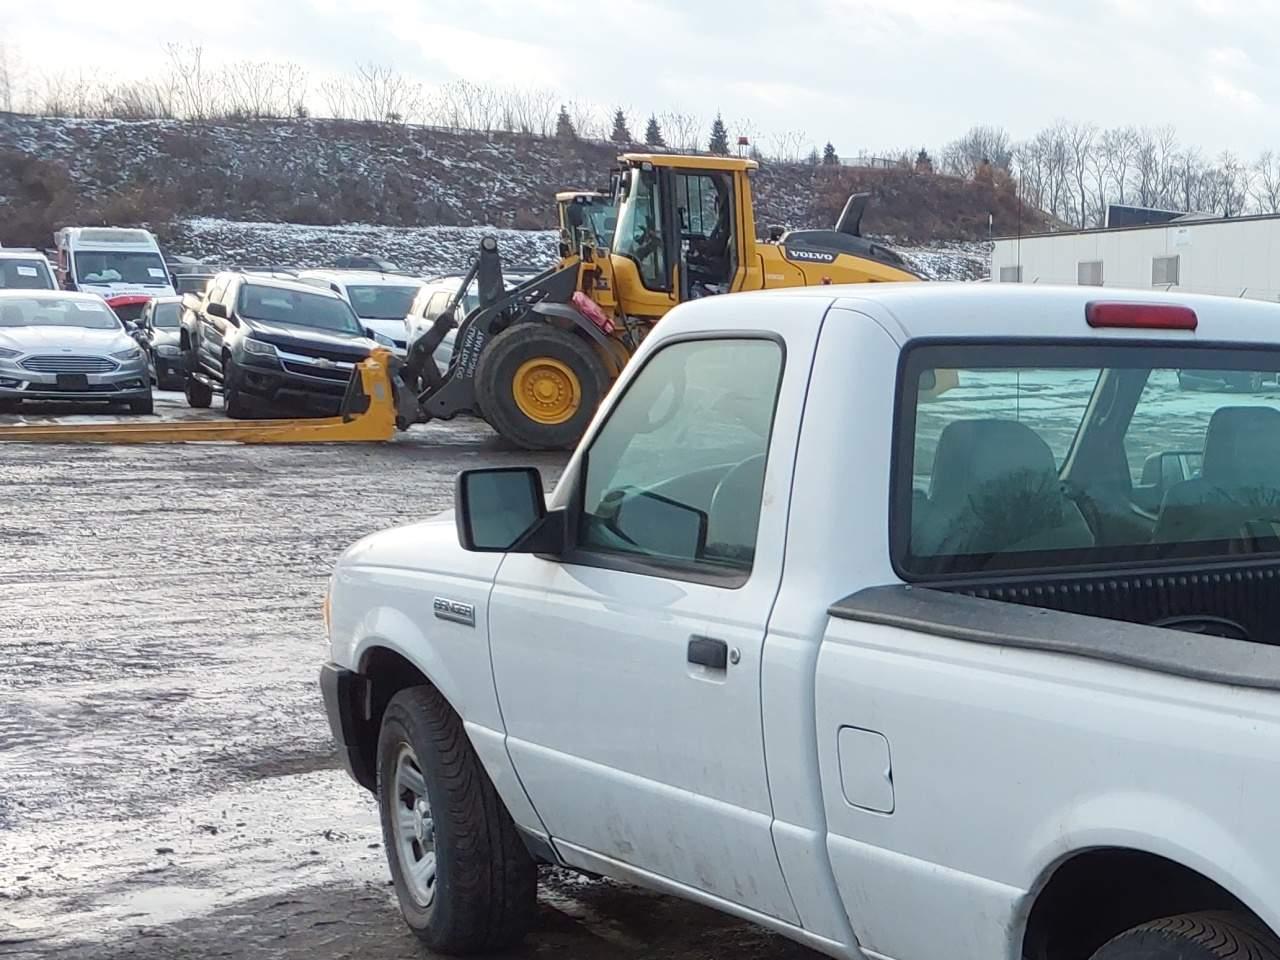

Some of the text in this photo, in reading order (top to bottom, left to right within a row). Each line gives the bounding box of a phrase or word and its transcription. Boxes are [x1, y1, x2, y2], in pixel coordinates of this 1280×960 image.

[790, 250, 833, 261] VOLVO
[460, 349, 471, 367] NOT
[433, 598, 473, 617] RANGER
